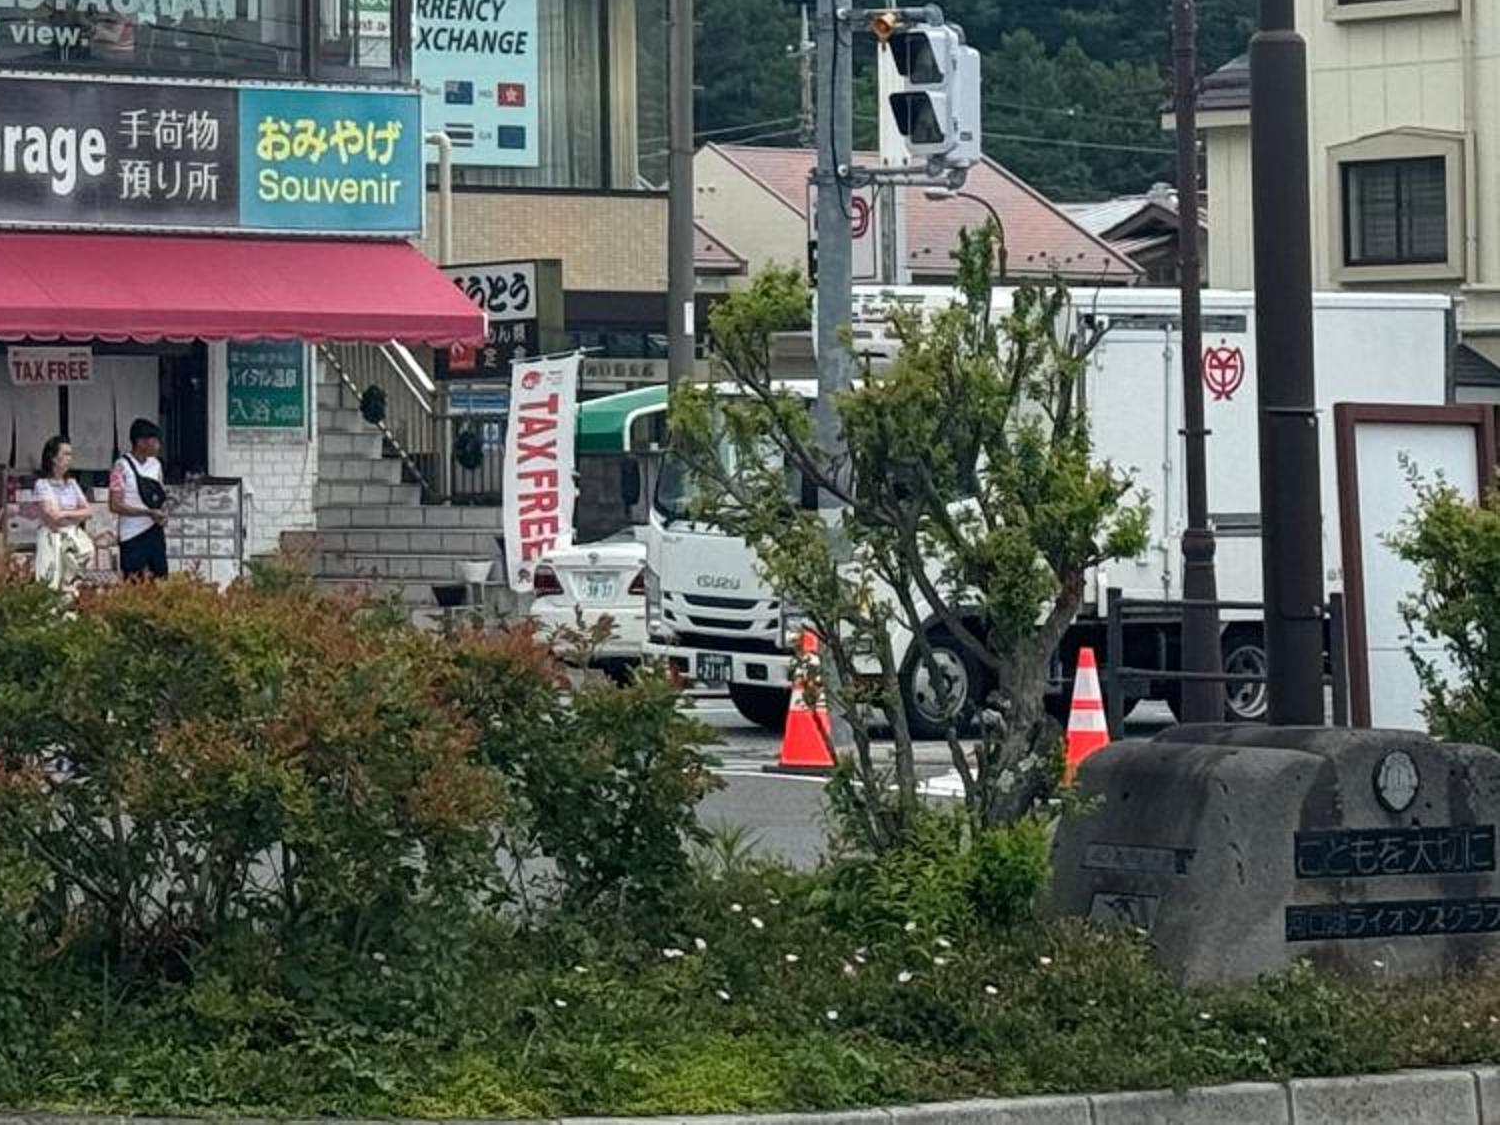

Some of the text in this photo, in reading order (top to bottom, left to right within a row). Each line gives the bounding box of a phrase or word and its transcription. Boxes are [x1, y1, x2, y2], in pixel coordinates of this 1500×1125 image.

[9, 19, 89, 47] view.
[416, 26, 529, 55] XCHANGE
[119, 108, 219, 151] 手荷物
[256, 116, 403, 165] おみやげ
[118, 159, 219, 201] 預り所
[258, 169, 403, 205] Souvenir
[453, 272, 530, 312] うとう
[12, 360, 90, 381] TAX FREE
[517, 393, 560, 564] TAX FREE
[697, 574, 740, 590] ISUZU
[1299, 830, 1492, 875] こどもを大切に
